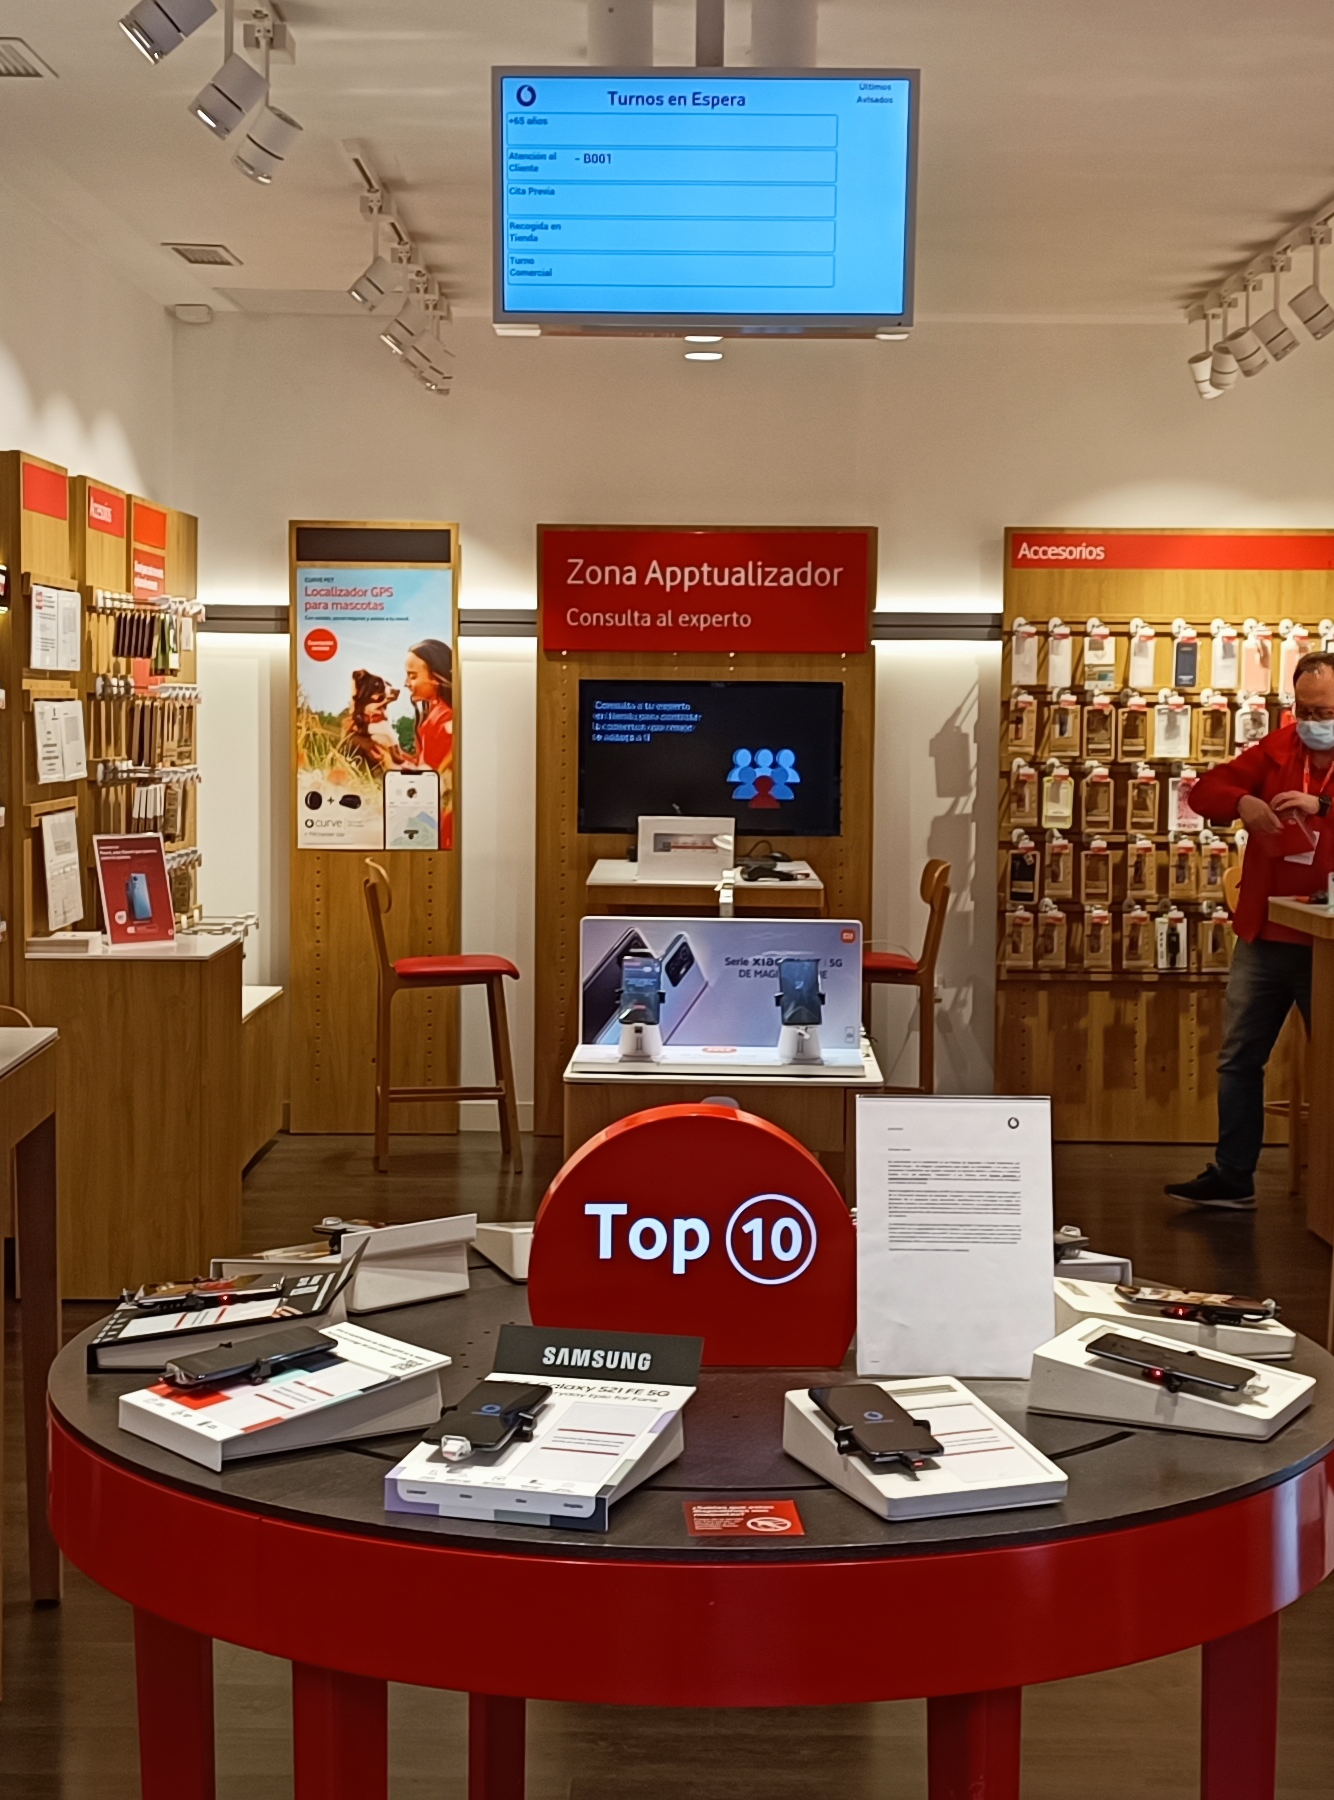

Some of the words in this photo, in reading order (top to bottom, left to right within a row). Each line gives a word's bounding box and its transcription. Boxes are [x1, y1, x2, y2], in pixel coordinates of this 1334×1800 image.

[607, 91, 664, 107] Turnos
[668, 94, 687, 106] en
[692, 92, 746, 109] Espera
[583, 153, 612, 164] B001
[509, 187, 527, 196] Cita
[528, 187, 555, 196] Previa
[509, 222, 549, 232] Recogida
[550, 223, 562, 231] en
[509, 234, 539, 243] Tienda
[509, 257, 535, 265] Turno
[509, 269, 553, 277] Comercial
[1017, 542, 1105, 560] Accesorios
[567, 559, 637, 586] Zona
[644, 560, 843, 592] Apptualizador
[304, 586, 368, 598] Localizador
[371, 586, 393, 598] GPS
[304, 601, 328, 612] para
[331, 601, 384, 611] mascotas
[566, 608, 651, 628] Consulta
[656, 610, 673, 627] al
[678, 612, 752, 631] experto
[725, 957, 749, 966] Serie
[829, 959, 843, 967] 5G
[738, 969, 752, 978] DE
[584, 1203, 710, 1275] Top
[741, 1217, 803, 1262] 10
[542, 1346, 652, 1372] SAMSUNG
[598, 1386, 623, 1394] S21
[624, 1388, 645, 1396] FE
[646, 1389, 670, 1397] 5G
